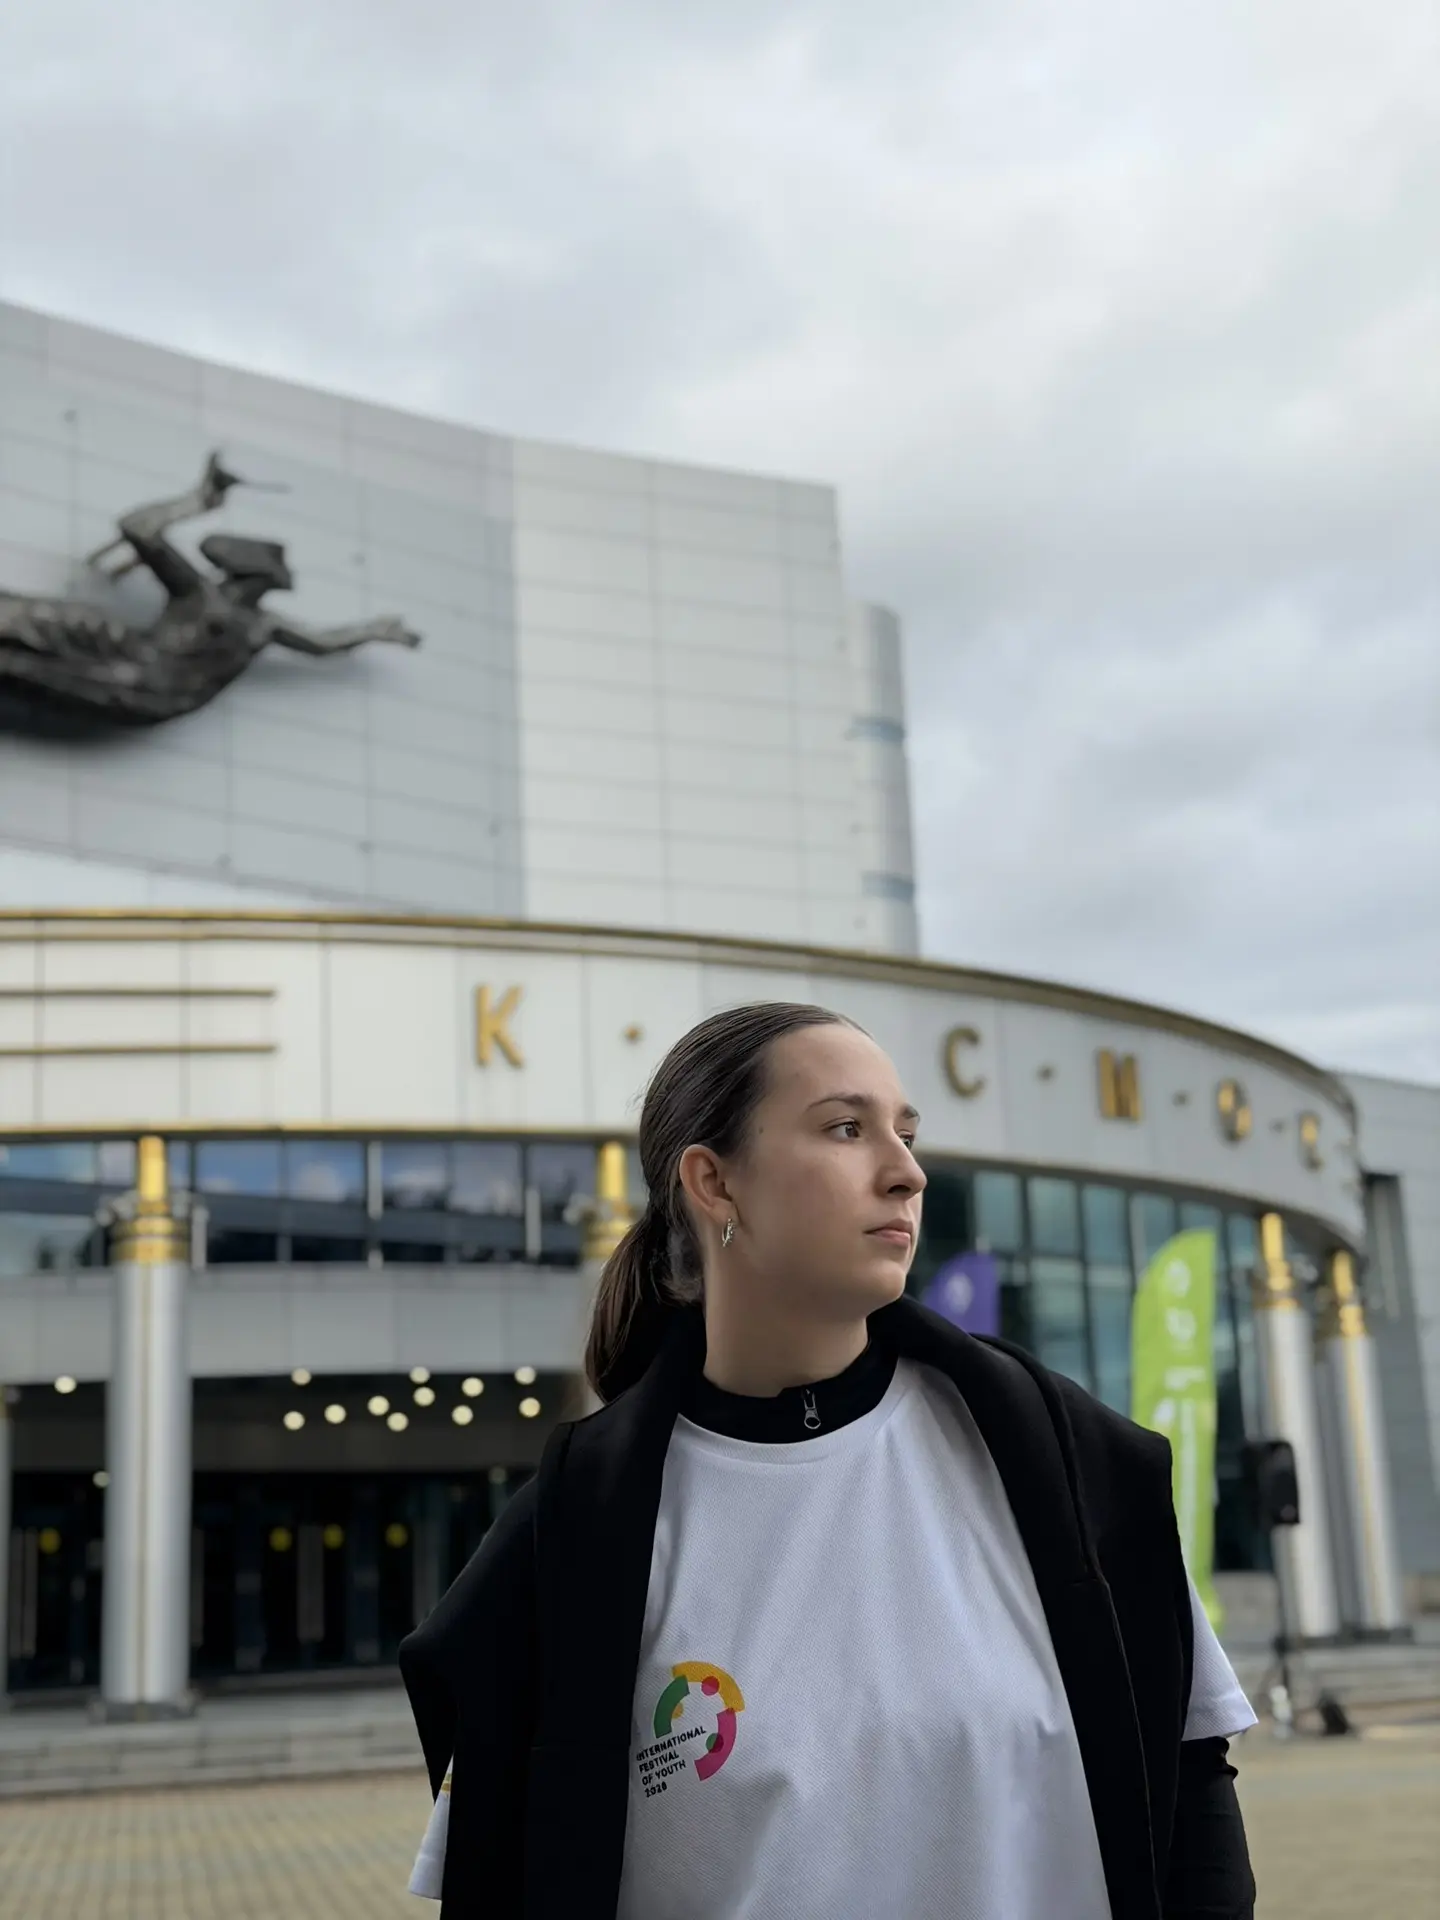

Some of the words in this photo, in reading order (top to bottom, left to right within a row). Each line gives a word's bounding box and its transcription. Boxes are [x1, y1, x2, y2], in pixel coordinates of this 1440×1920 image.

[636, 1726, 707, 1761] INTERNATIONAL
[639, 1750, 680, 1773] FESTIVAL
[642, 1773, 654, 1786] OF
[655, 1759, 687, 1780] YOUTH
